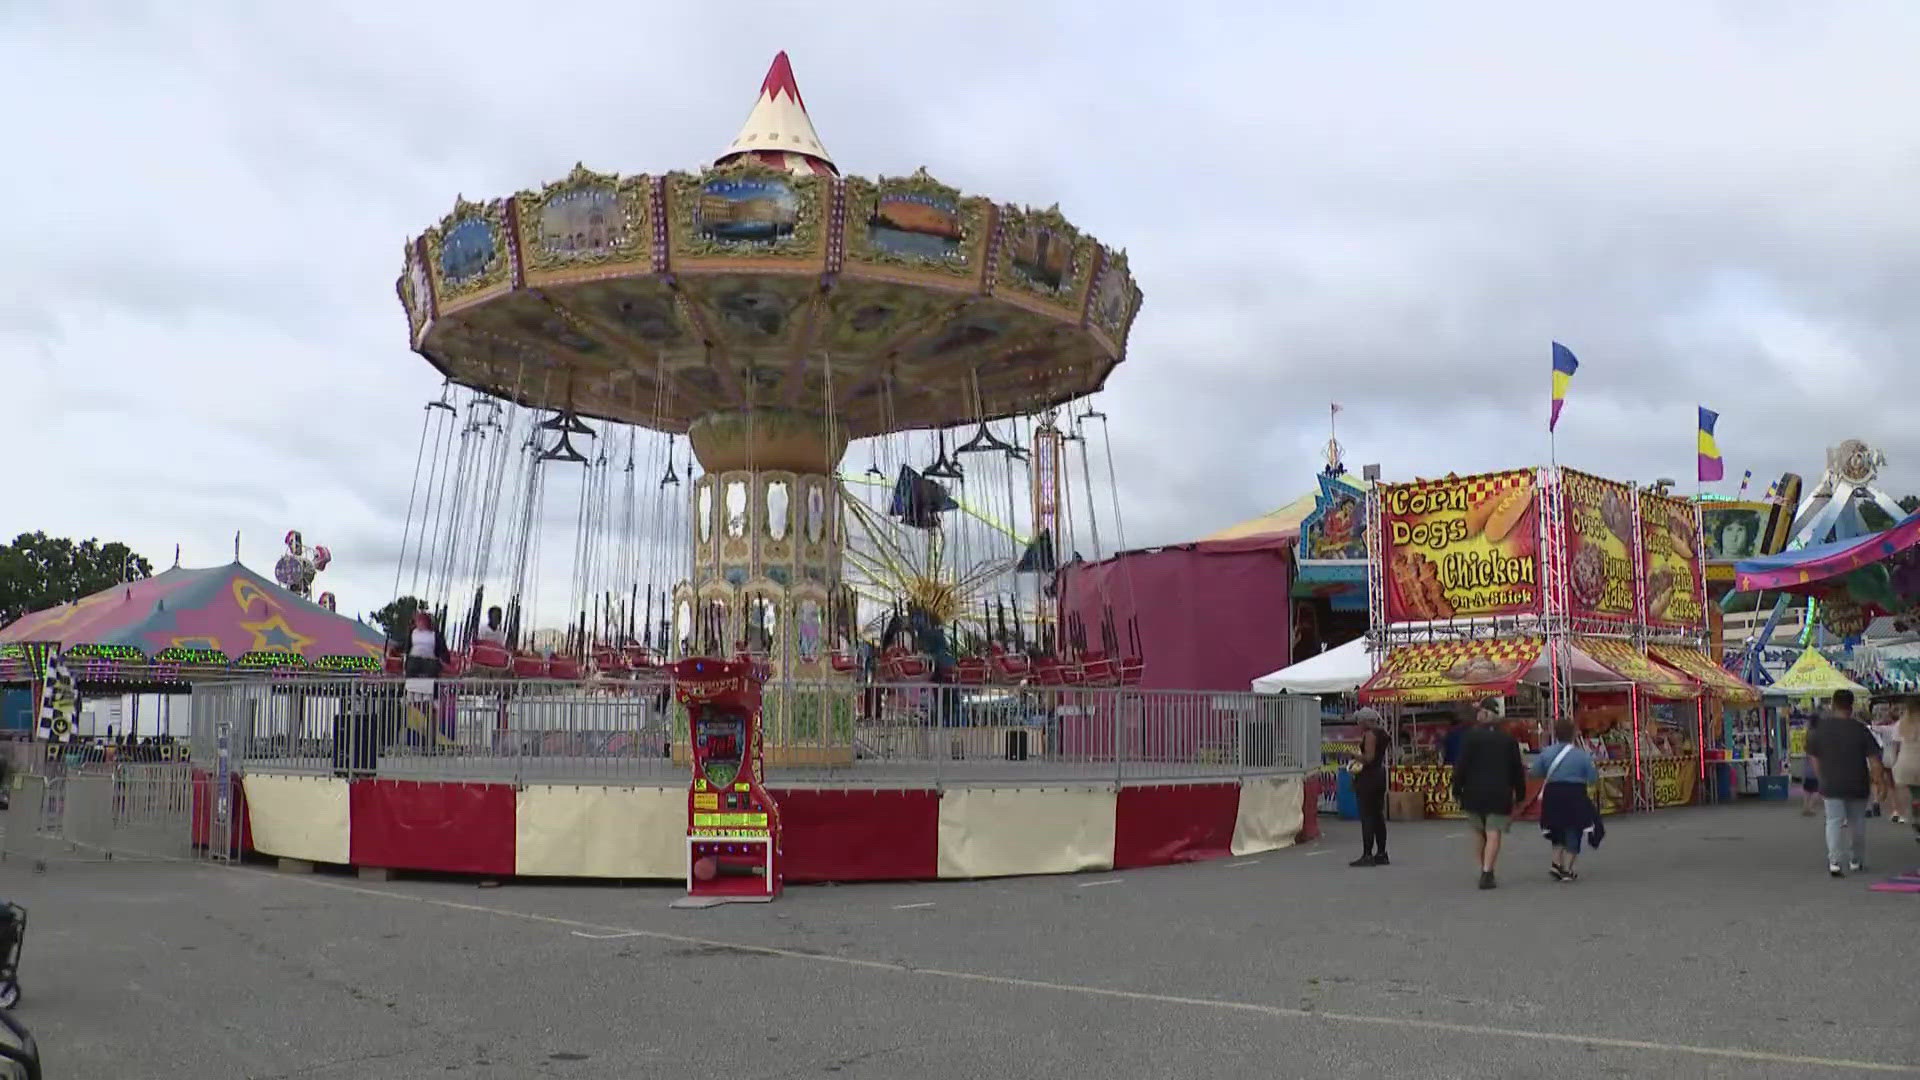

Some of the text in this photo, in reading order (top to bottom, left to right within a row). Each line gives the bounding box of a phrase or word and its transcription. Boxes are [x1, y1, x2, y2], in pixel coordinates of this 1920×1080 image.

[1391, 486, 1468, 515] Corn
[1568, 475, 1602, 508] Fried
[1391, 519, 1468, 549] Dogs
[1572, 507, 1607, 540] Oreos
[1443, 549, 1536, 590] Chicken
[1603, 551, 1634, 580] Funnel
[1474, 592, 1486, 608] A
[1489, 588, 1532, 606] Stick
[1604, 581, 1634, 610] Cakes
